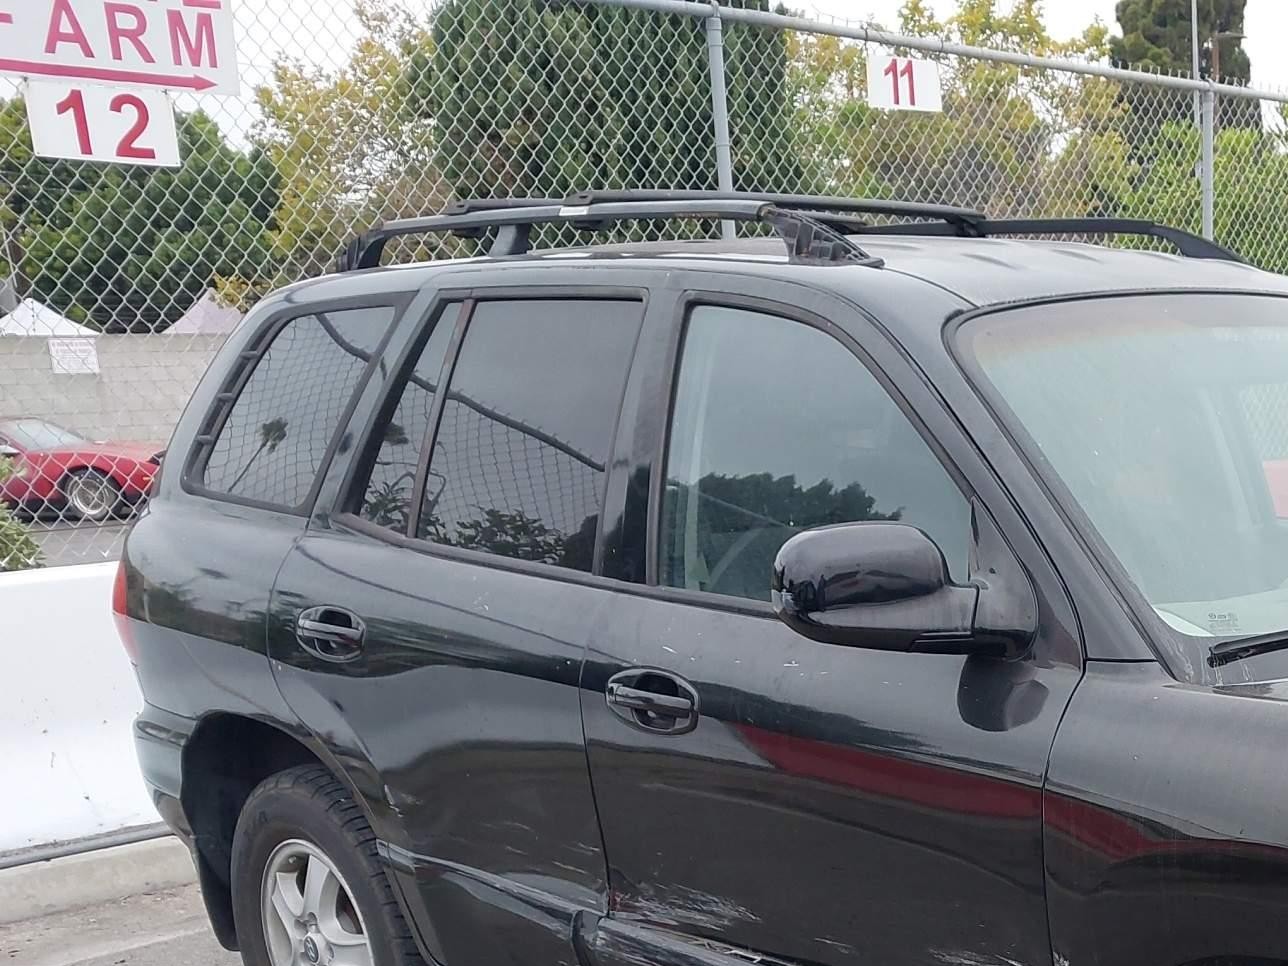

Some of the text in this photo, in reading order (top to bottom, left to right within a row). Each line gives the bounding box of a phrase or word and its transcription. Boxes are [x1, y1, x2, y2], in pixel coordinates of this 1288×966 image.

[0, 0, 219, 68] ARM
[884, 58, 915, 106] 11
[56, 89, 156, 160] 12
